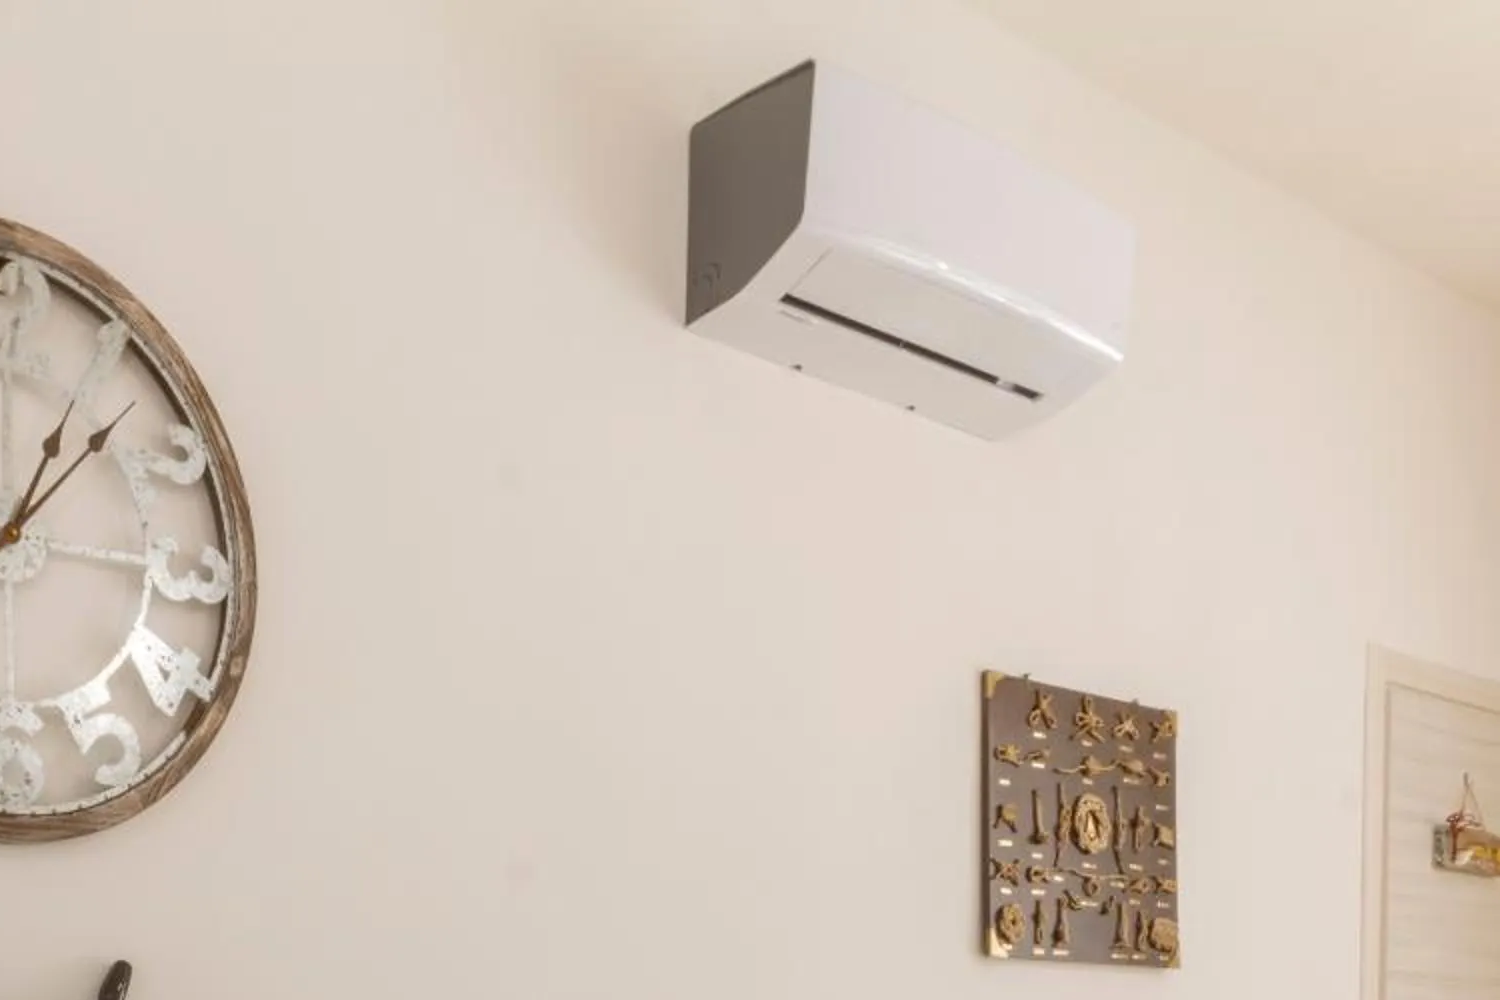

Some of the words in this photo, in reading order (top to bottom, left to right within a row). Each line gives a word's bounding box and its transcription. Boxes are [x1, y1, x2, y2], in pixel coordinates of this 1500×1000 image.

[72, 317, 134, 430] 1
[112, 422, 206, 508] 2
[148, 534, 233, 604] 3
[128, 622, 213, 717] 4
[58, 679, 141, 786] 5
